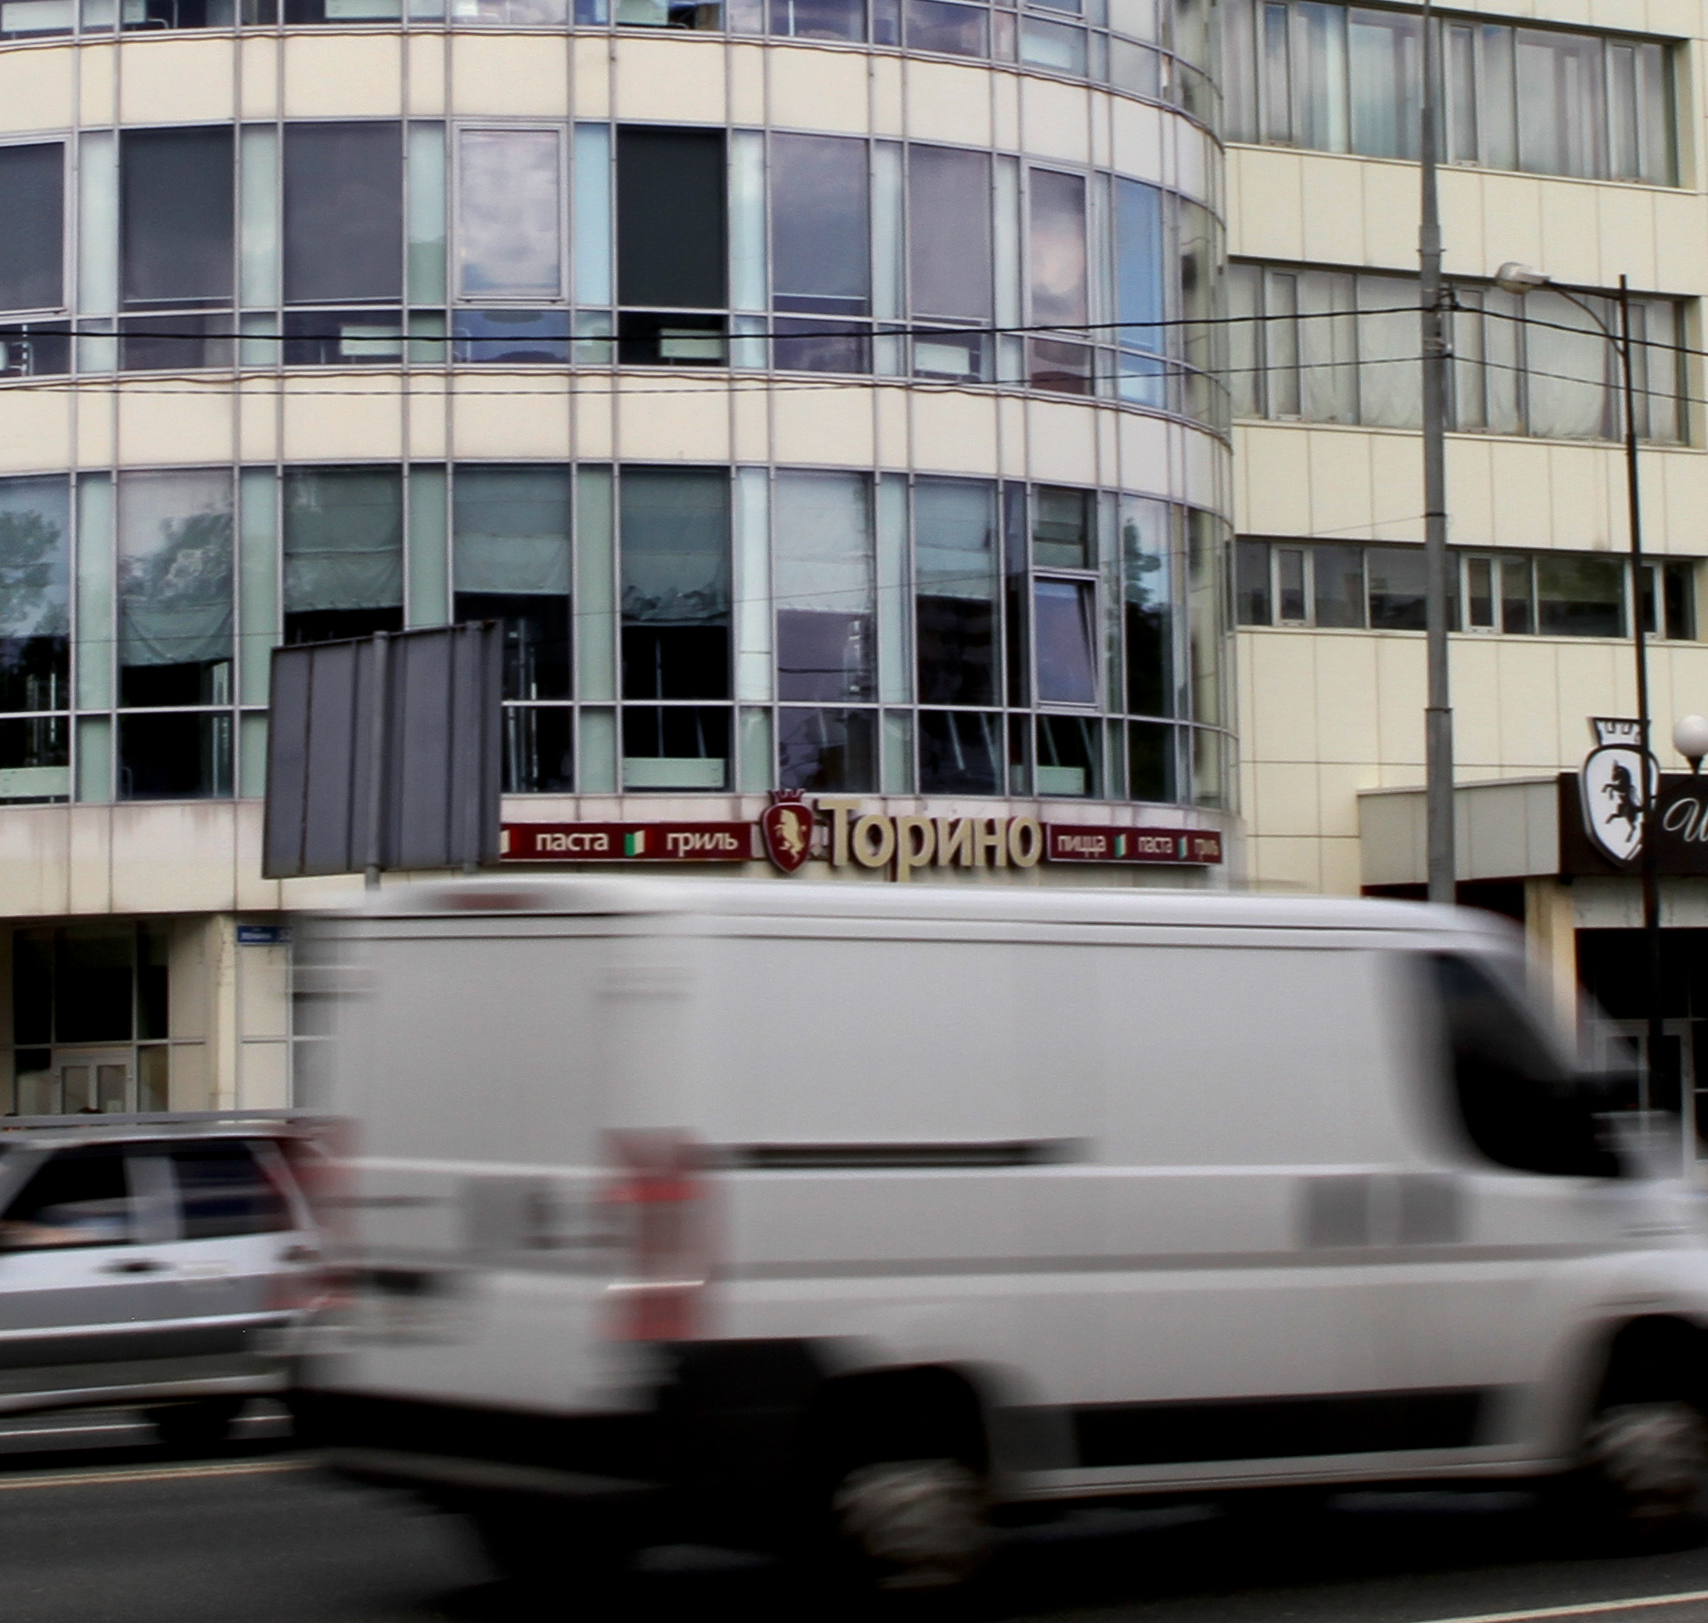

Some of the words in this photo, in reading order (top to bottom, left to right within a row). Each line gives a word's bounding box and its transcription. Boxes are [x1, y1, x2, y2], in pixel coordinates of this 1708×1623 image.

[535, 832, 610, 852] паста
[666, 833, 738, 858] гриль
[816, 798, 1042, 883] Торино
[1057, 835, 1107, 858] пицца
[1138, 836, 1174, 854] паста
